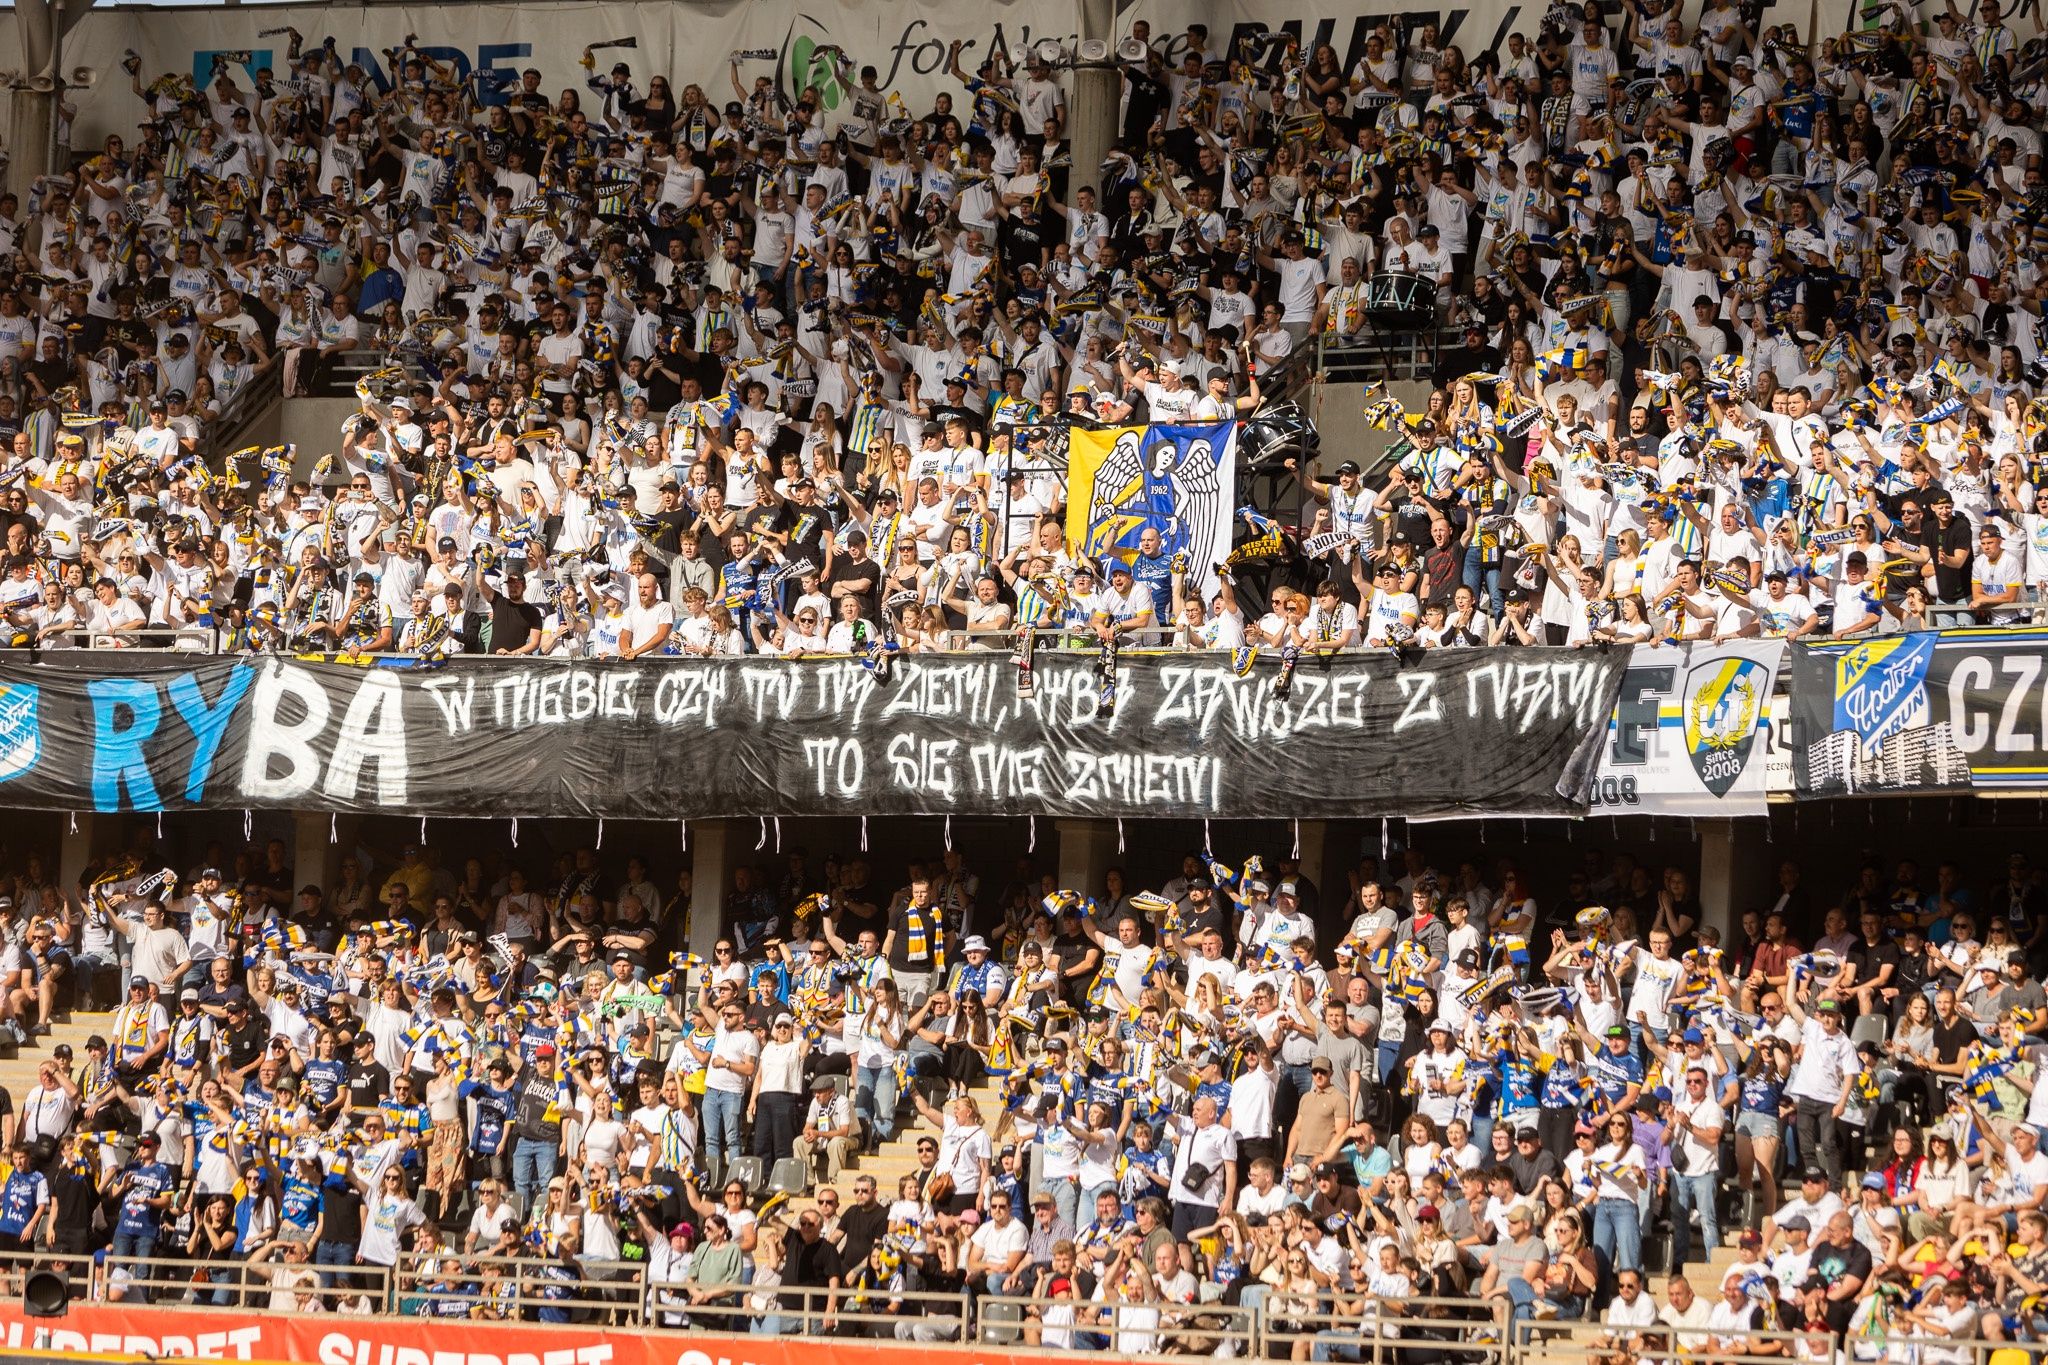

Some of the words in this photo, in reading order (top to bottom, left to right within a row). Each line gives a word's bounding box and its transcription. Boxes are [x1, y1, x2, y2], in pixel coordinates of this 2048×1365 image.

[1150, 485, 1168, 495] 1962
[421, 675, 475, 737] W
[654, 665, 726, 729] CZY
[742, 665, 802, 723] TU
[817, 664, 877, 732] NA
[1393, 671, 1446, 735] Z
[1845, 639, 1930, 733] Apator
[1947, 654, 2048, 753] CZ
[87, 658, 408, 813] RYBA
[803, 735, 865, 799] TO
[970, 740, 1049, 801] NIE
[1704, 748, 1736, 765] since
[1702, 759, 1742, 782] 2008
